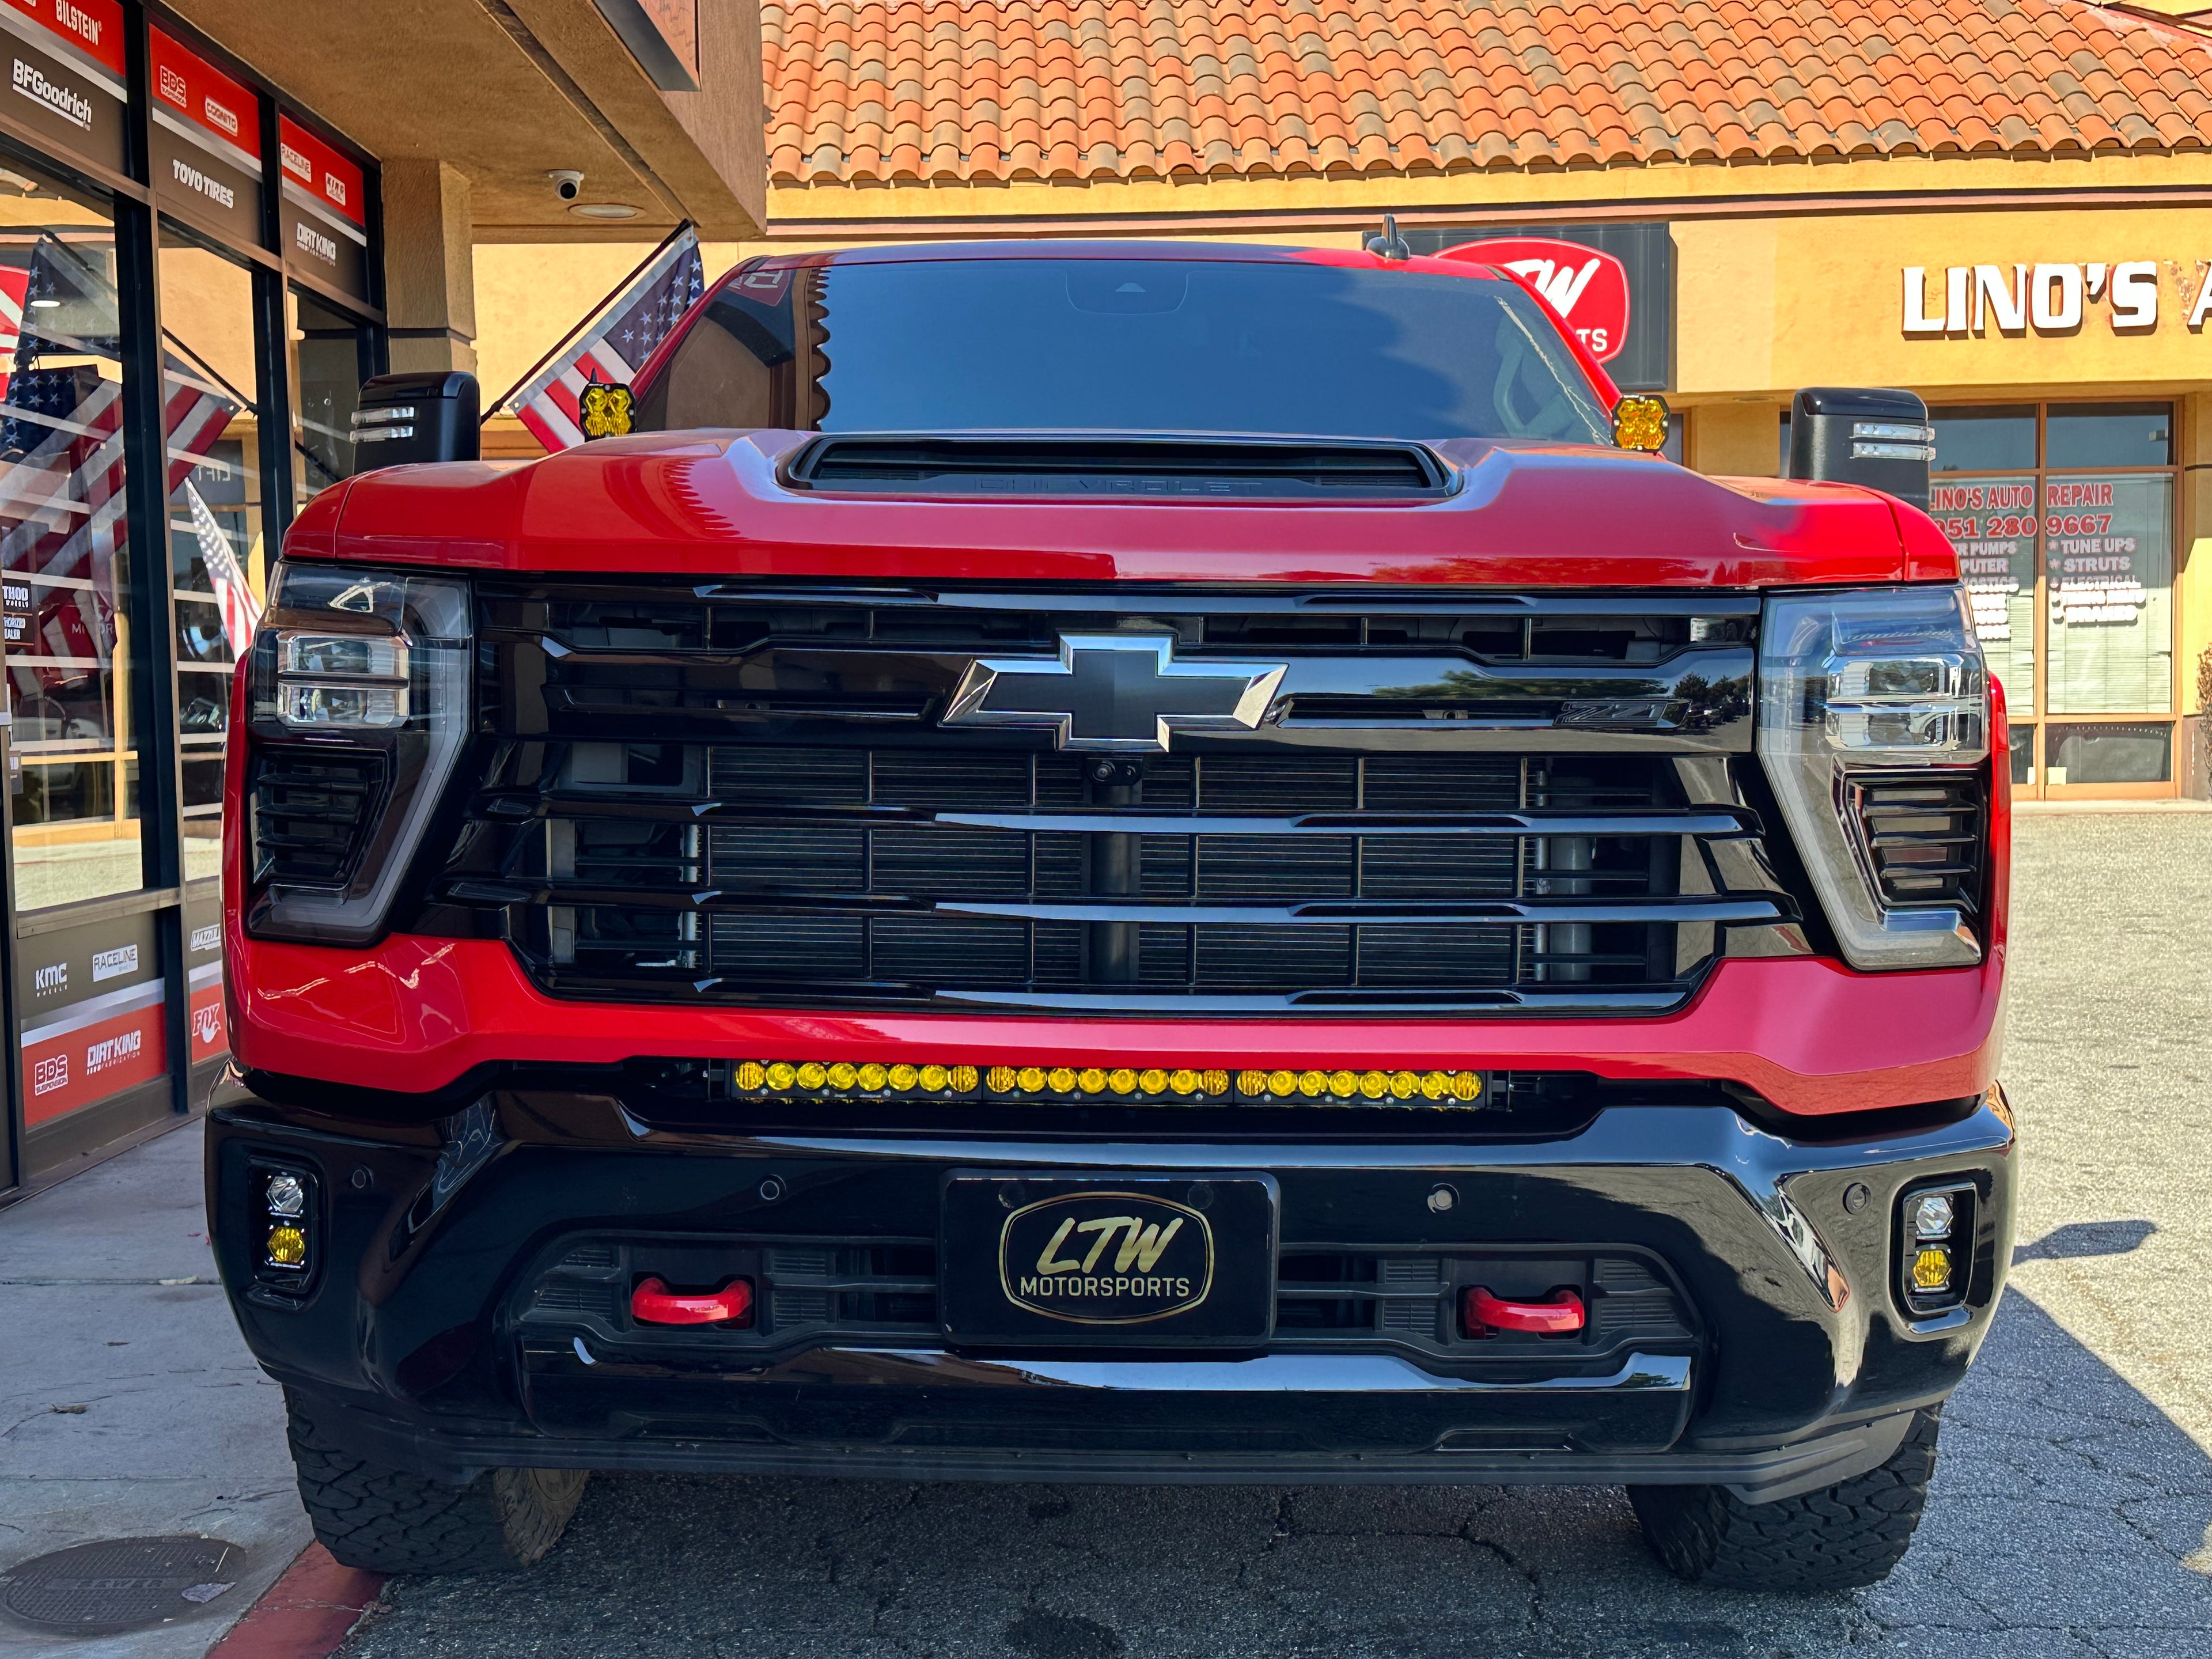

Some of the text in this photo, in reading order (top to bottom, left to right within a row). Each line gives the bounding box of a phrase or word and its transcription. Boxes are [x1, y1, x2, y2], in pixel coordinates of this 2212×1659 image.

[13, 58, 92, 123] BFGoodrich
[161, 66, 186, 99] BDS
[173, 159, 234, 209] TOYO TIRES
[1902, 261, 2157, 339] LINO'S
[975, 479, 1262, 493] CHEVROLET
[1987, 484, 2033, 510] AUTO
[2047, 483, 2113, 507] REPAIR
[1986, 514, 2037, 539] 280
[2046, 512, 2112, 537] 9667
[1970, 541, 2017, 556] PUMPS
[2061, 537, 2136, 554] TUNE UPS
[1960, 557, 2009, 574] PUTER
[2063, 556, 2131, 573] STRUTS
[36, 963, 67, 990] KMC
[192, 1003, 221, 1037] FOX
[88, 1030, 141, 1067] DIRT KING
[36, 1055, 68, 1085] BDS
[1036, 1216, 1184, 1275] LTW
[1020, 1276, 1190, 1297] MOTORSPORTS
